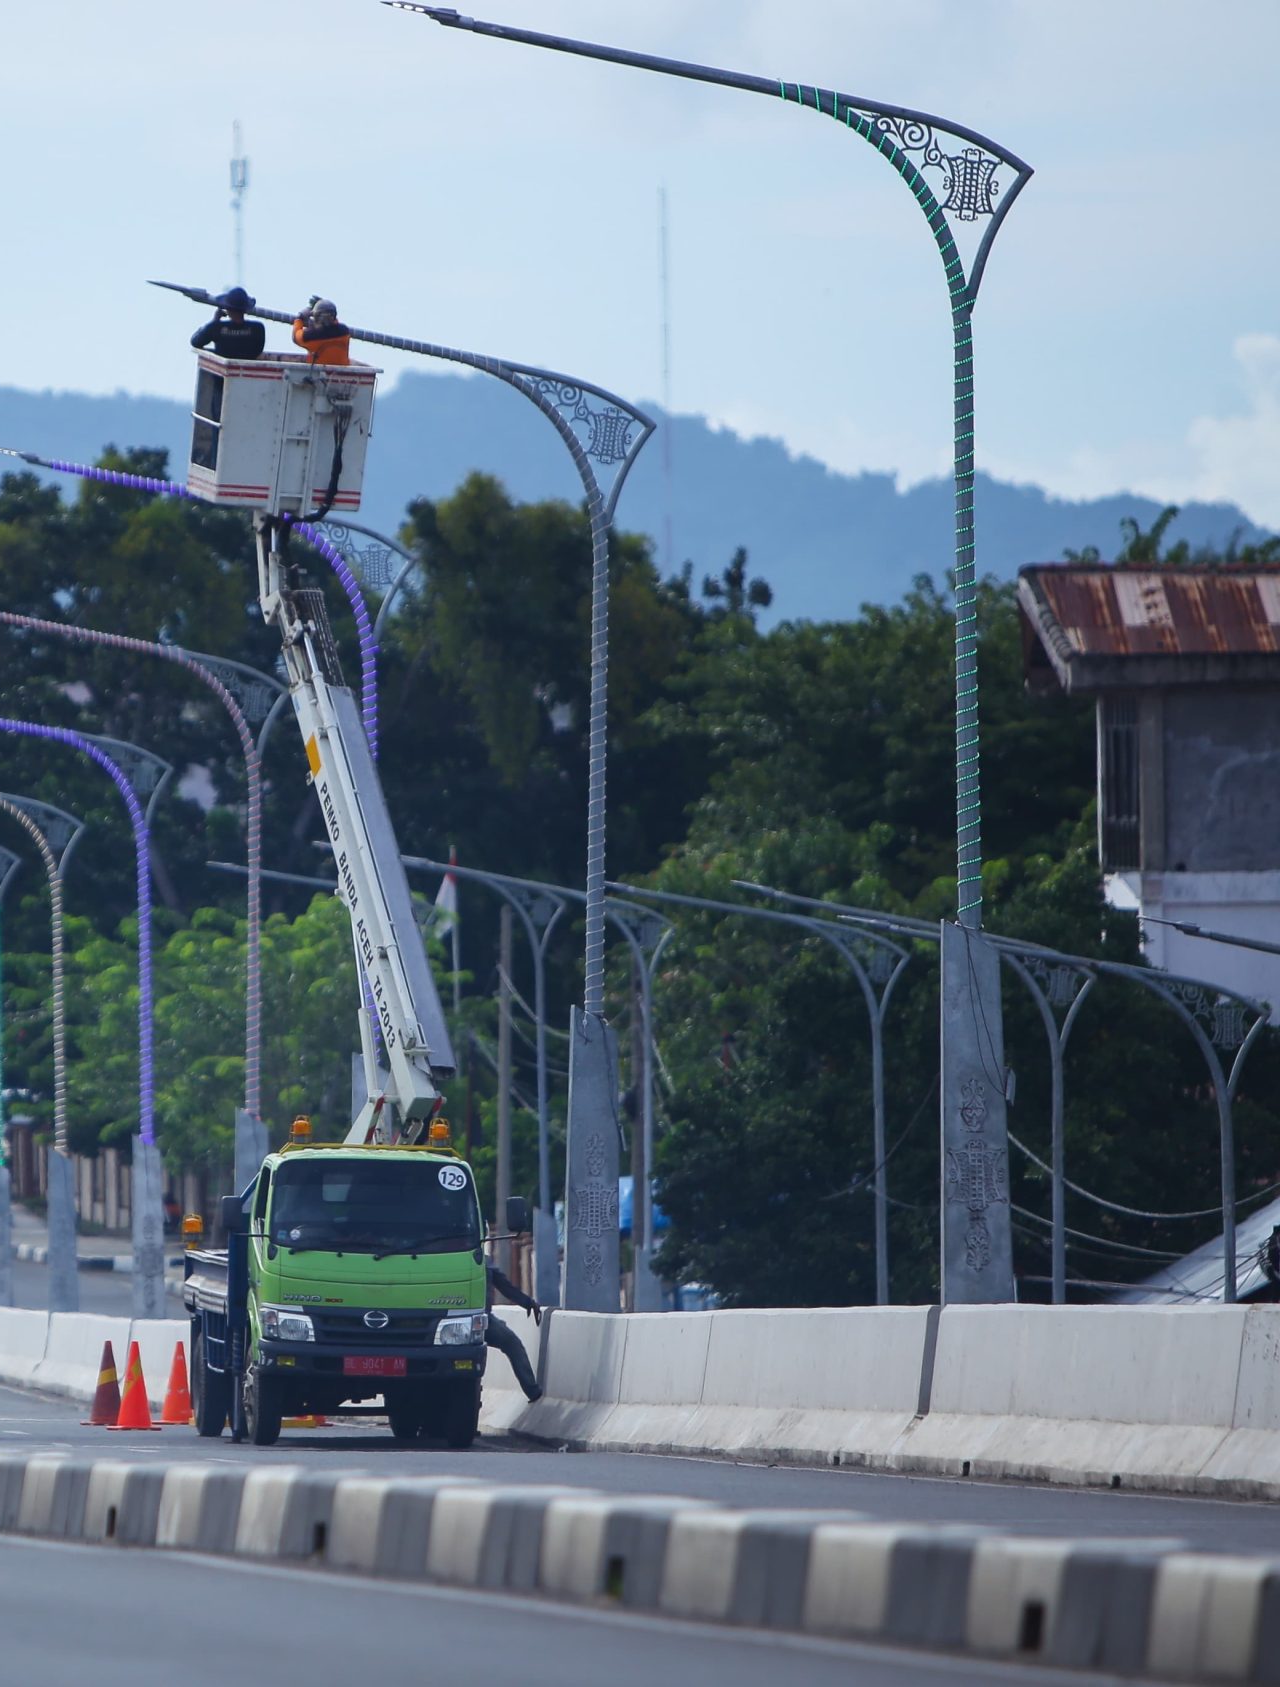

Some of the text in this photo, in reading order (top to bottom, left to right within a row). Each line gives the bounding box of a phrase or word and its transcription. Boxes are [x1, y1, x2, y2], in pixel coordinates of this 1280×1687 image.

[320, 781, 396, 1048] PEMKO BANDA ACEH TA 2013
[441, 1171, 465, 1188] 129
[283, 1294, 322, 1303] HINO
